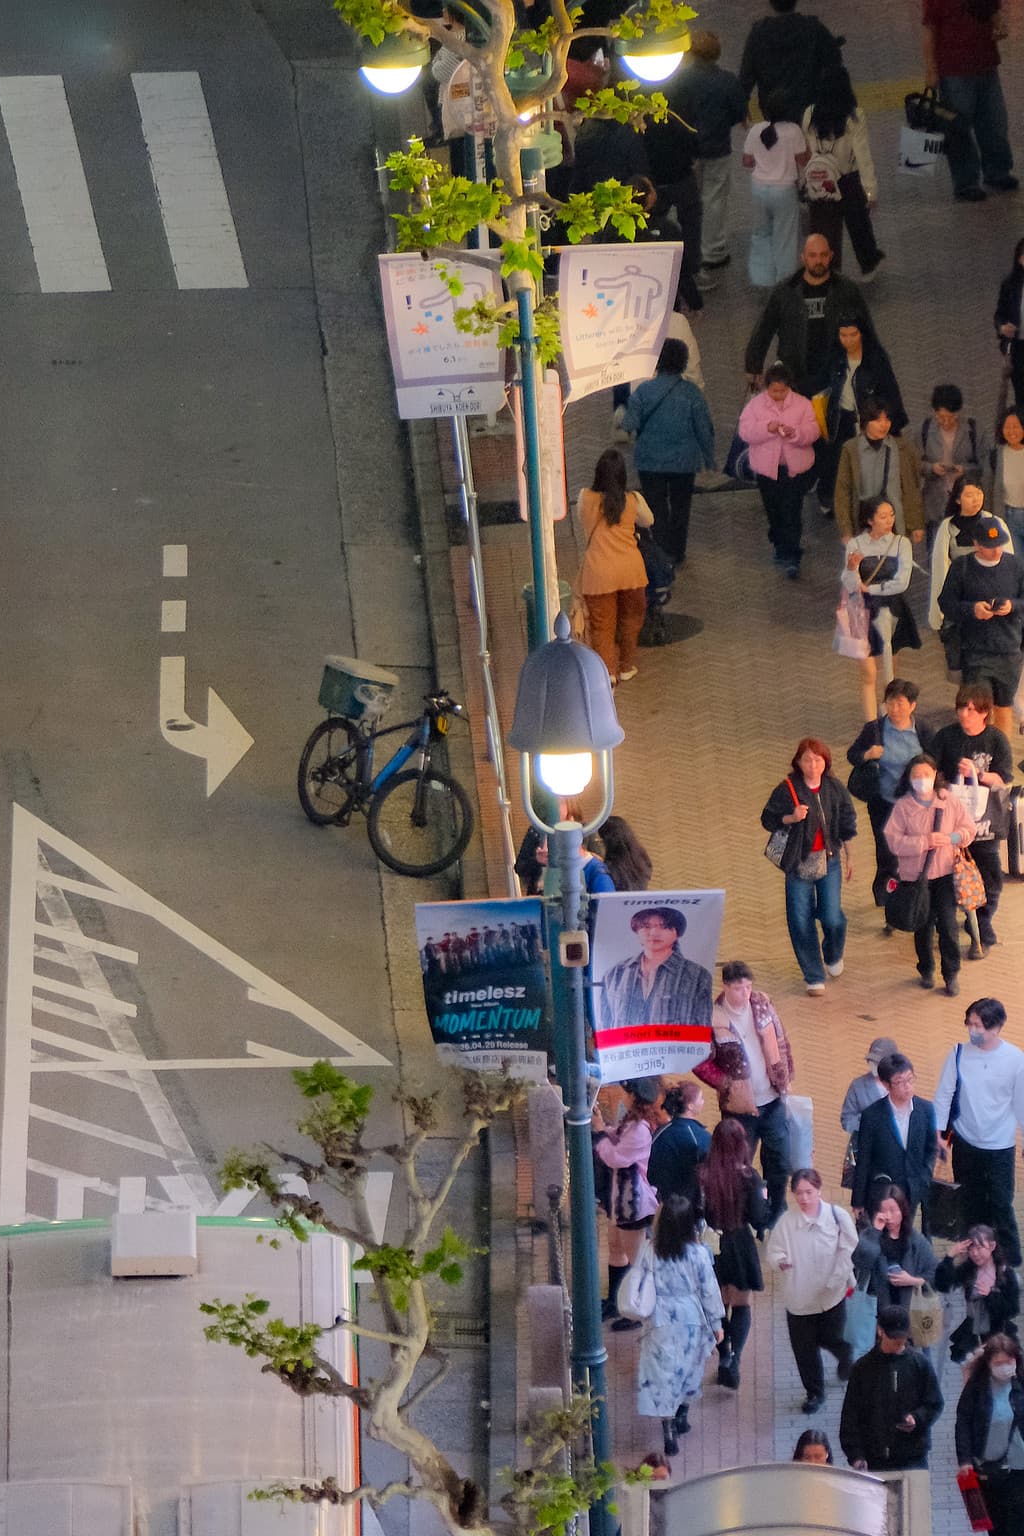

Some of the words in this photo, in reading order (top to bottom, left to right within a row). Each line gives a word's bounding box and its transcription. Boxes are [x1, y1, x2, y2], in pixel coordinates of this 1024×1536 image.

[623, 898, 703, 907] timelesz
[444, 985, 526, 1005] timelesz
[433, 1004, 542, 1035] MOMENTUM
